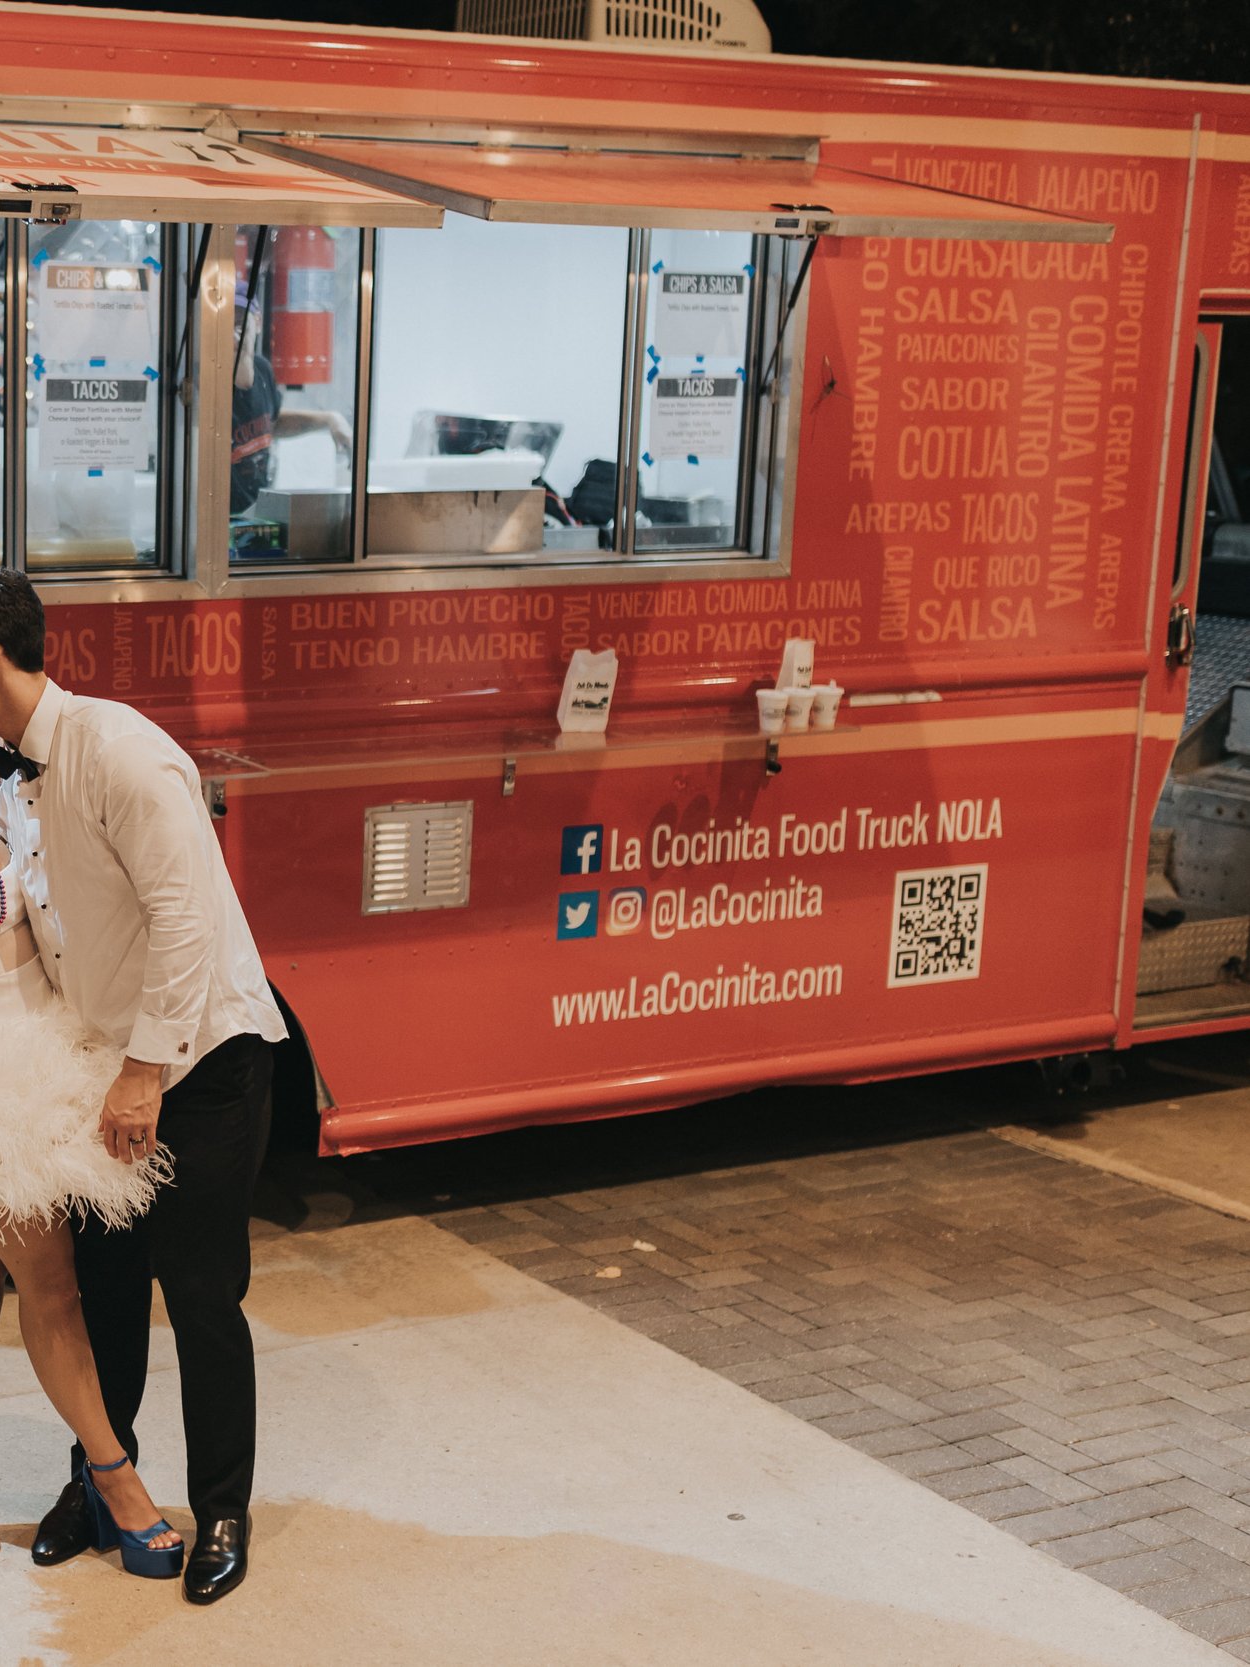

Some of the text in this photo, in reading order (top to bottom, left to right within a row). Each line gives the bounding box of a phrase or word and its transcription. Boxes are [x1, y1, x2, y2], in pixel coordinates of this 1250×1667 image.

[0, 155, 44, 165] LA
[57, 158, 168, 172] CALLE
[1029, 159, 1160, 214] JALAPEÑO
[56, 268, 91, 289] CHIPS
[903, 236, 1109, 282] GUASACACA
[670, 275, 738, 295] CHIPS & SALSA
[893, 286, 1020, 326] SALSA
[896, 333, 1021, 365] PATACONES
[71, 380, 119, 400] TACOS
[677, 379, 716, 397] TACOS
[849, 307, 886, 483] HAMBRE
[899, 376, 1011, 412] SABOR
[1015, 306, 1062, 479] CILANTRO
[898, 425, 1010, 481] COTIJA
[1046, 295, 1109, 611] COMIDA LATINA
[1093, 243, 1149, 631] CHIPOTLE CREMA AREPAS
[845, 500, 952, 535] AREPAS
[962, 491, 1040, 545] TACOS
[879, 546, 914, 642] CILANTRO
[933, 554, 1041, 596] QUE RICO
[291, 592, 554, 631] BUEN PROVECHO
[597, 580, 863, 621] VENEZUELA COMIDA LATINA
[915, 595, 1038, 644] SALSA
[112, 608, 137, 691] JALAPEÑO
[146, 611, 242, 678] TACOS
[261, 606, 277, 681] SALSA
[288, 631, 546, 670] TENGO HAMBRE
[598, 617, 863, 658] SABOR PATACONES
[608, 797, 1004, 872] La Cocinita Food Truck NOLA
[650, 875, 824, 940] @LaCocinita
[551, 962, 844, 1028] www.LaCocinita.com
